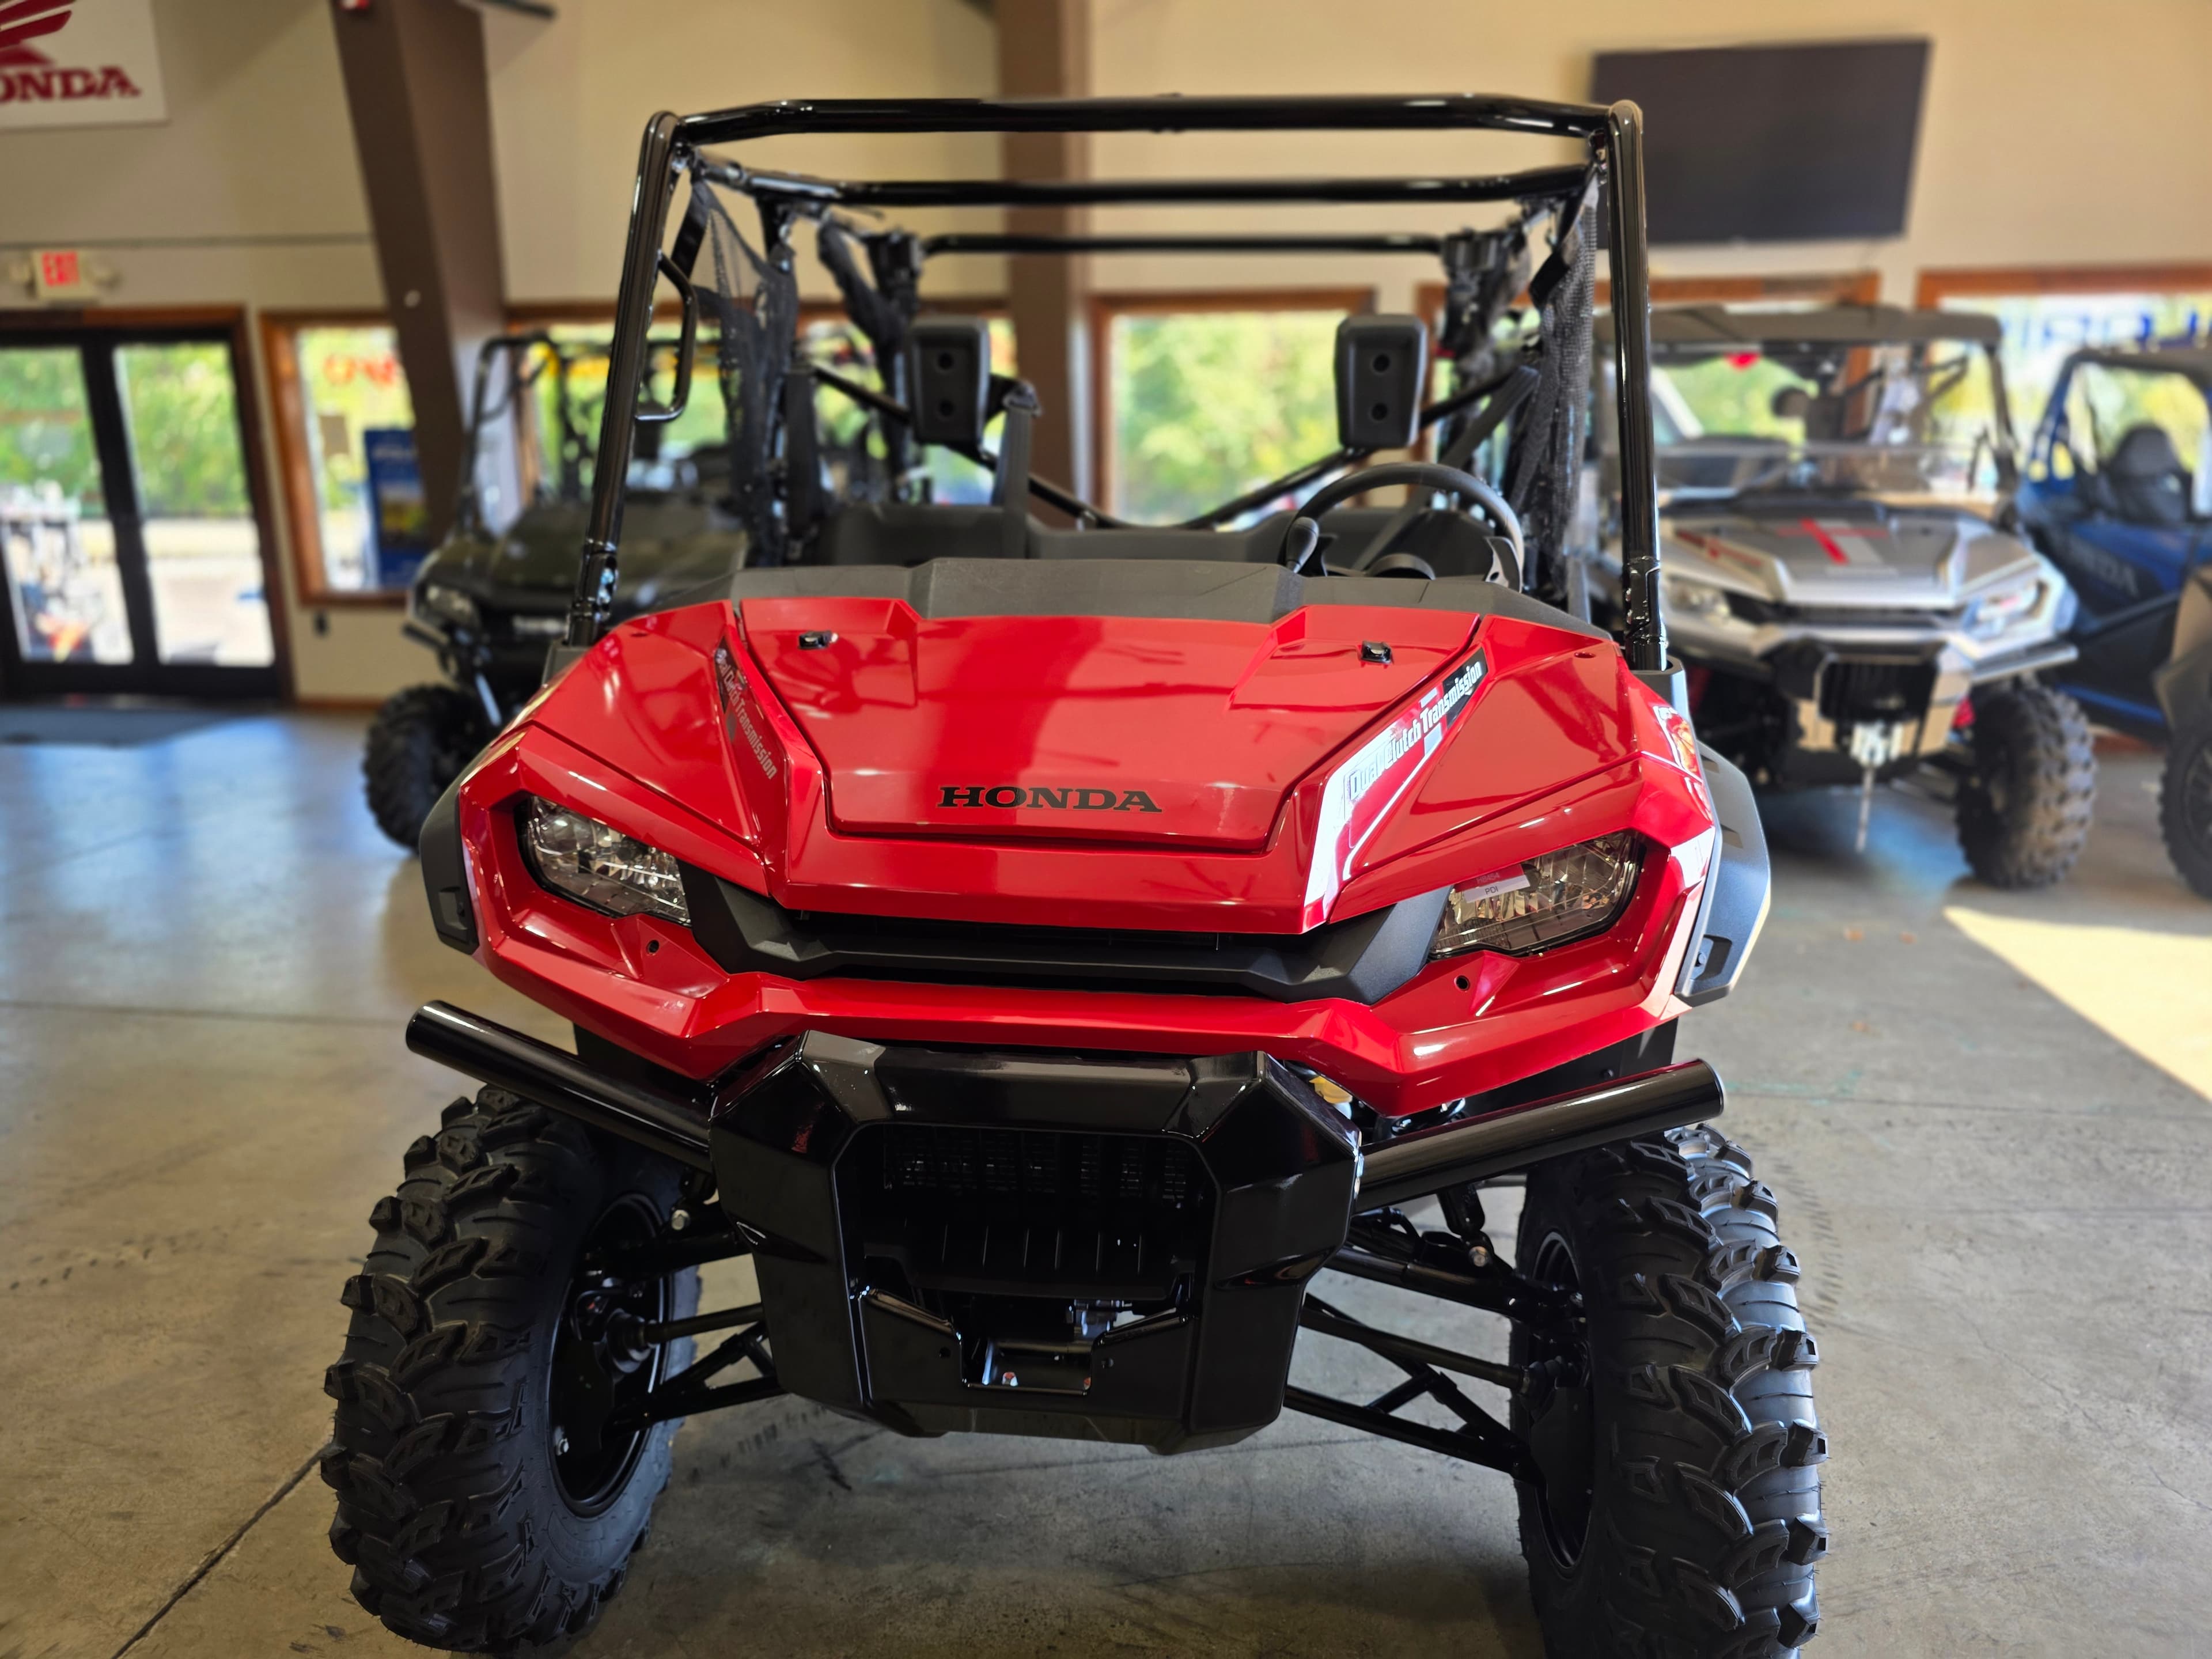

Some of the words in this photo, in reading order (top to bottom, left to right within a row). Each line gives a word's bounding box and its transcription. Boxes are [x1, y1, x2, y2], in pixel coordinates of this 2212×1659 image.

[734, 698, 778, 779] Transmission
[1349, 752, 1384, 801] Dual
[1384, 718, 1422, 770] Clutch
[1420, 661, 1483, 733] Transmission
[937, 786, 1162, 813] HONDA
[1484, 885, 1499, 895] PDI
